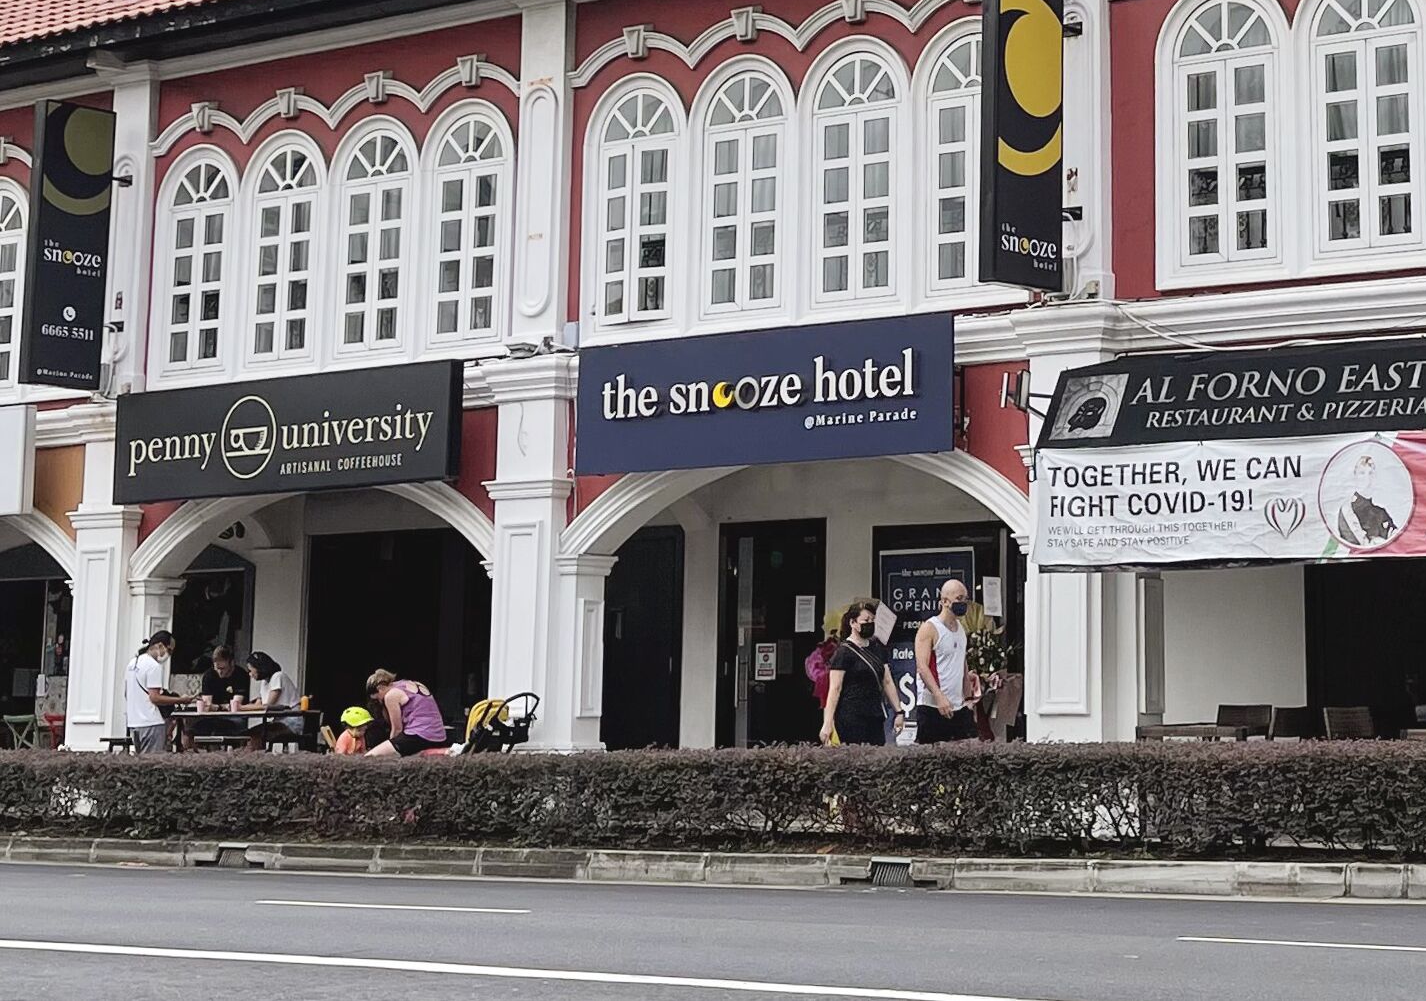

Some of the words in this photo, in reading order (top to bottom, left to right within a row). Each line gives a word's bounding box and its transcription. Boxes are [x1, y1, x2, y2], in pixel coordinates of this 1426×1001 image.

[1001, 223, 1016, 233] the
[43, 248, 101, 267] snooze
[1001, 234, 1057, 259] snooze
[41, 324, 69, 338] 6665
[71, 327, 94, 341] 5511
[602, 373, 658, 420] the
[669, 372, 802, 415] snooze
[814, 348, 914, 403] hotel
[1130, 375, 1177, 405] AL
[1187, 366, 1327, 401] FORNO
[804, 413, 864, 430] @Marine
[870, 407, 918, 422] Parade
[1146, 403, 1294, 428] RESTAURANT
[1296, 402, 1315, 421] &
[128, 431, 216, 477] penny
[281, 403, 434, 452] university
[280, 459, 331, 475] ARTISANAL
[338, 453, 403, 471] COFFEEHOUSE
[1047, 461, 1188, 487] TOGETHER,
[1197, 458, 1237, 482] WE
[1246, 455, 1302, 480] CAN
[1050, 494, 1119, 517] FIGHT
[1127, 489, 1253, 516] COVID-19!
[1158, 523, 1180, 533] THIS
[1047, 538, 1068, 547] STAY
[1071, 537, 1094, 547] SAFE
[1097, 537, 1119, 547] AND
[1121, 537, 1144, 546] STAY
[893, 587, 941, 600] GRAN
[893, 600, 941, 612] OPENI
